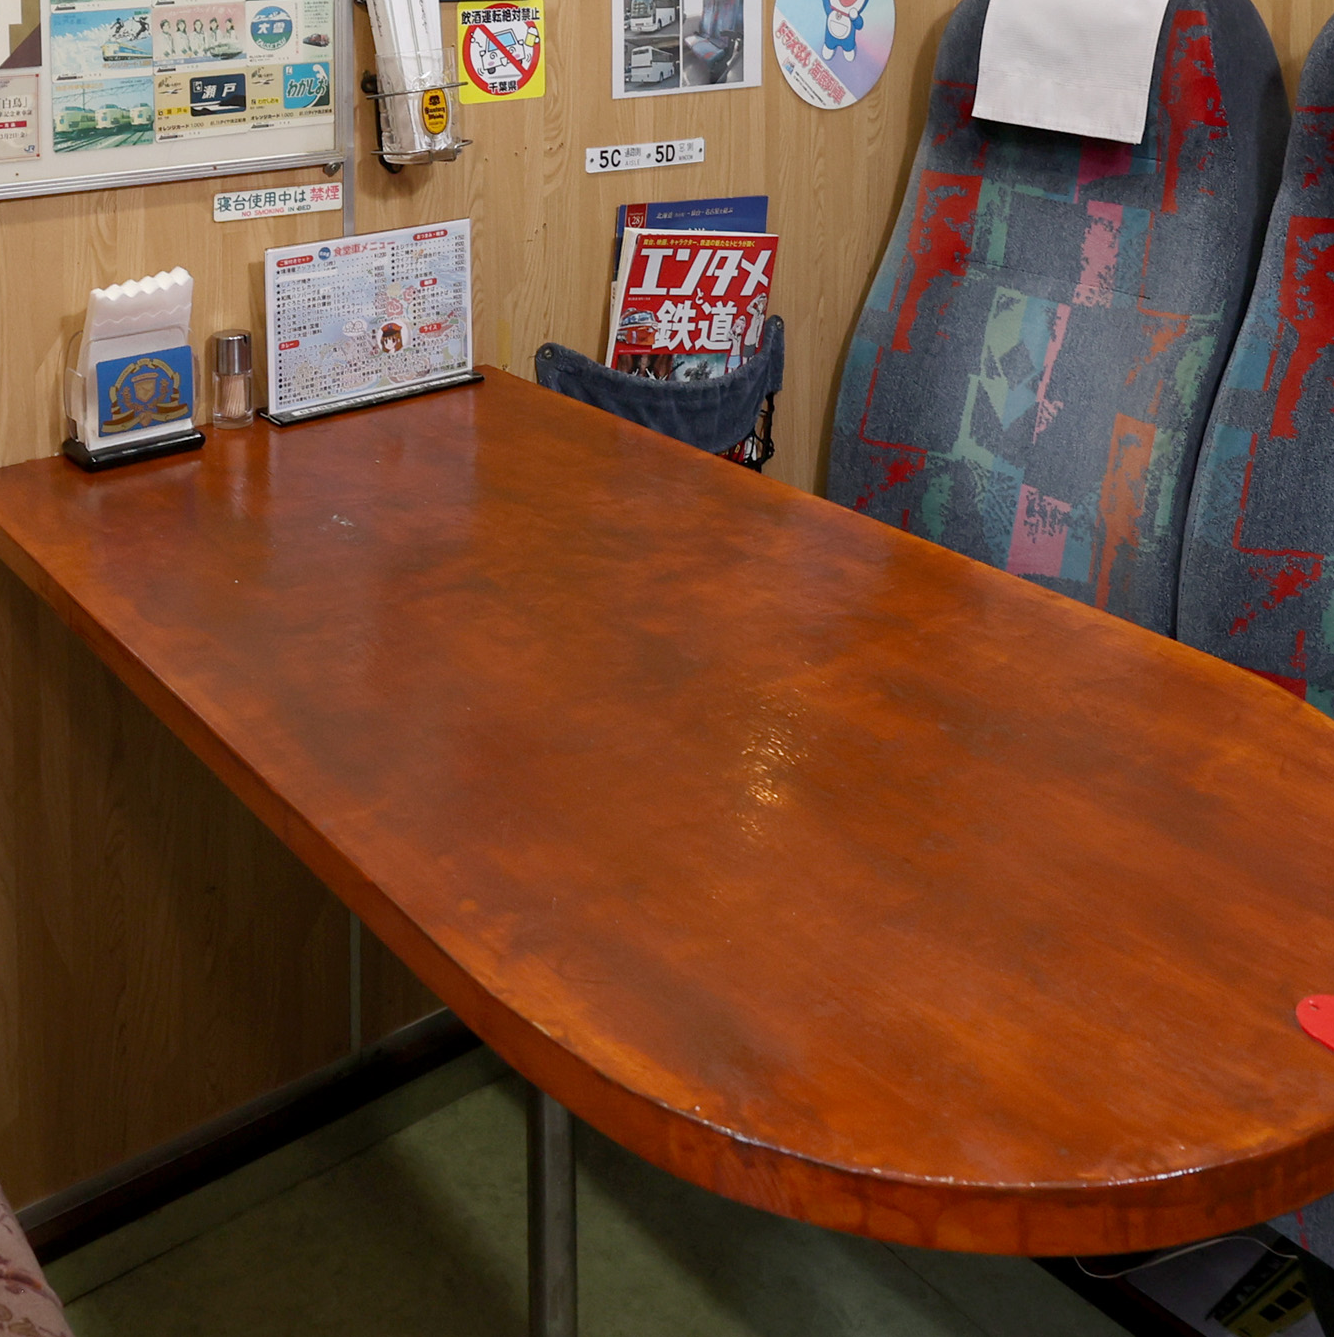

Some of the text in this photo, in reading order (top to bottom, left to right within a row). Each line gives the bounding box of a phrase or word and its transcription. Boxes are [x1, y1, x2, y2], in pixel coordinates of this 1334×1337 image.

[461, 8, 541, 25] 飲酒運転絶対禁止
[257, 22, 285, 35] 大雪
[202, 82, 238, 99] 瀬戸
[286, 77, 328, 98] わかしお
[488, 81, 517, 93] 千葉県
[808, 60, 846, 105] 海底列車
[250, 113, 280, 122] オレンジカード
[158, 123, 190, 131] オレンジカード
[24, 145, 36, 153] JR
[655, 144, 676, 164] 5D
[598, 148, 622, 168] 5C
[254, 207, 285, 216] SMOKING
[632, 216, 641, 225] 28
[333, 241, 396, 258] 食堂車メニュー
[628, 248, 772, 296] エンタメ
[695, 288, 704, 304] と
[652, 300, 738, 351] 鉄道
